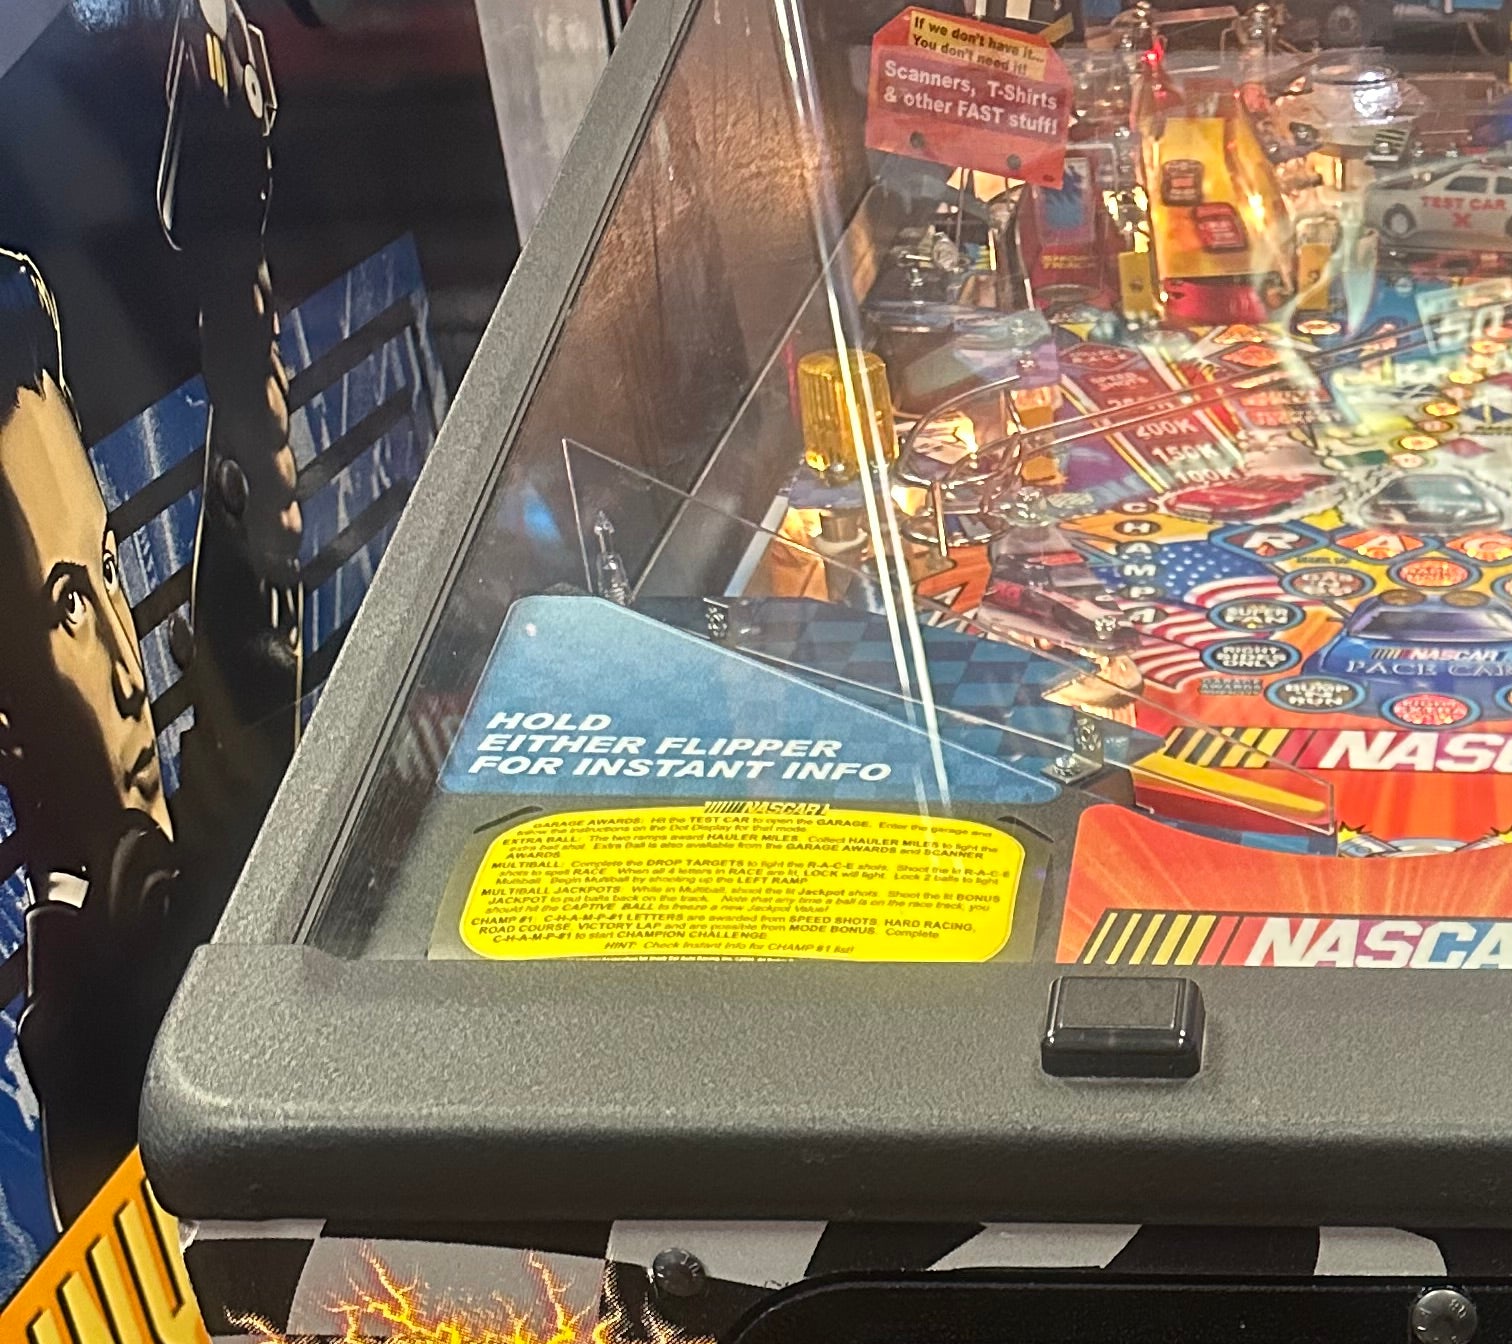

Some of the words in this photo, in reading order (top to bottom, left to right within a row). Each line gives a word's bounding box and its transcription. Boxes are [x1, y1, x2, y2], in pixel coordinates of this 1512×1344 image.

[914, 16, 926, 29] If
[929, 22, 947, 37] we
[951, 28, 985, 47] don't
[988, 37, 1019, 55] have
[913, 34, 937, 51] You
[940, 43, 974, 60] don't
[977, 54, 1010, 70] need
[1014, 62, 1027, 75] it!
[884, 60, 976, 97] Scanners,
[987, 81, 1057, 110] T-Shirts
[883, 86, 897, 103] &
[904, 91, 953, 114] other
[957, 99, 1005, 124] FAST
[1009, 114, 1058, 135] stuff!
[1421, 196, 1465, 209] TEST
[1470, 198, 1507, 211] CAR
[1410, 648, 1500, 662] NASCAR
[1346, 659, 1437, 676] PACE
[486, 712, 611, 731] HOLD
[477, 734, 647, 754] EITHER
[655, 737, 842, 758] FLIPPER
[468, 756, 563, 775] FOR
[572, 757, 776, 778] INSTANT
[782, 761, 892, 781] INFO
[741, 801, 820, 815] NASCAR
[488, 896, 546, 905] JACKPOT
[957, 894, 1000, 902] BONUS
[471, 917, 517, 925] CHAMP
[789, 915, 831, 923] SPEED
[885, 919, 920, 927] HARD
[479, 925, 515, 934] ROAD
